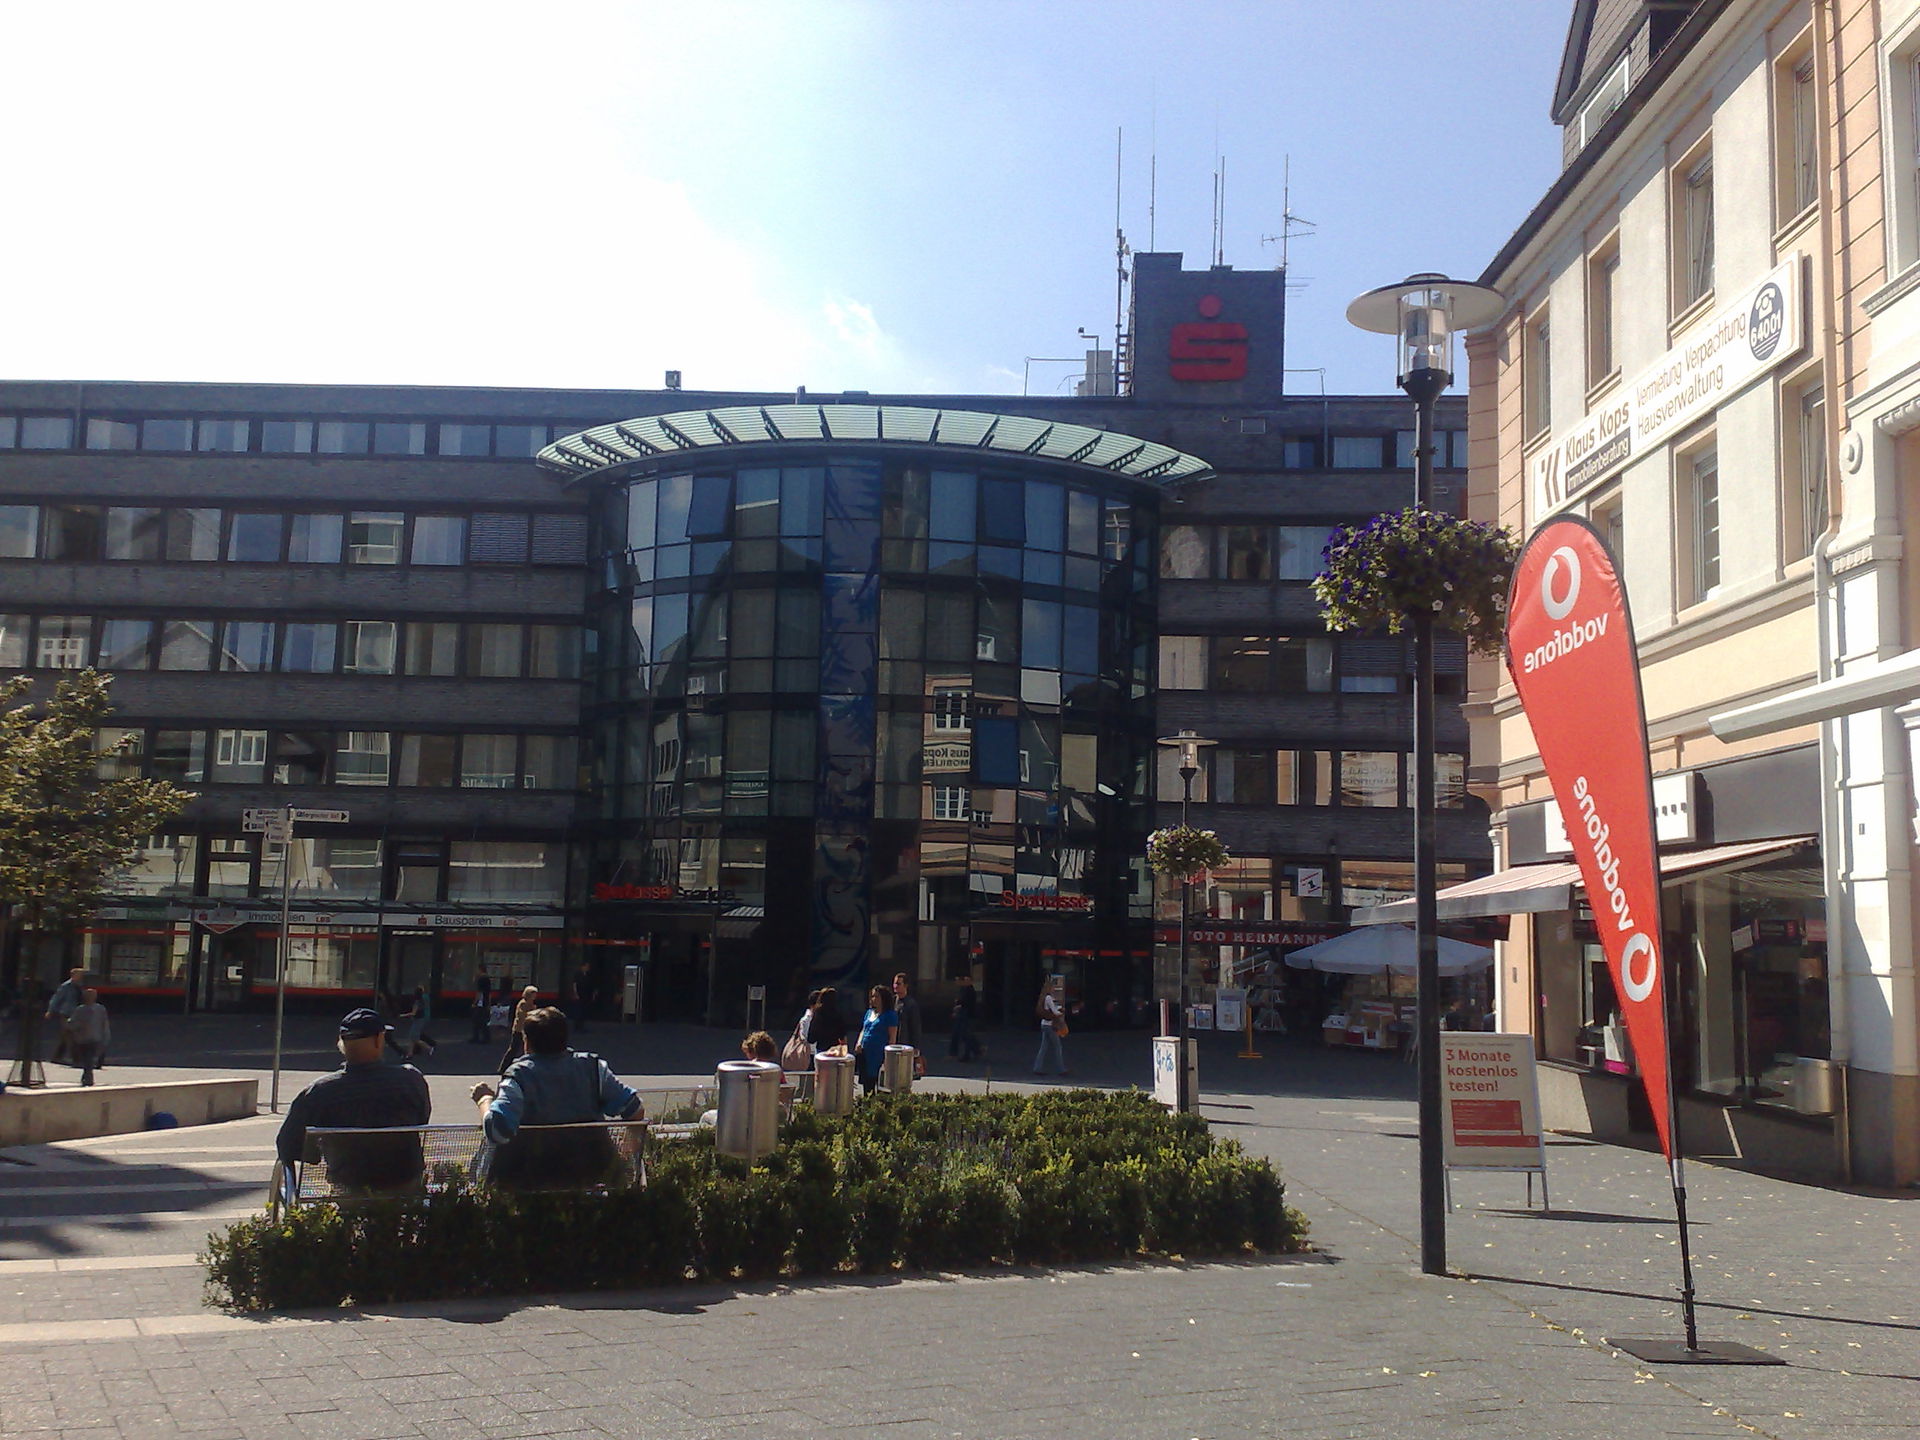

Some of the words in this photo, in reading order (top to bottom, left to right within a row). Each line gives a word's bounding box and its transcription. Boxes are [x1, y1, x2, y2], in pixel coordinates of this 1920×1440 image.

[1750, 311, 1782, 347] 64001
[1636, 361, 1682, 408] Vermietung
[1685, 312, 1746, 372] Verpachtung
[1637, 364, 1724, 440] Hausverwaltung
[1565, 428, 1595, 467] Klaus
[1599, 402, 1629, 441] Kops
[1567, 437, 1629, 492] Immobilienberatung
[434, 915, 492, 926] Bausparen
[1187, 930, 1226, 942] OTO
[1445, 1048, 1455, 1061] 3
[1458, 1050, 1511, 1062] Monate
[1447, 1064, 1518, 1077] kostenlos
[1448, 1080, 1499, 1092] testen!
